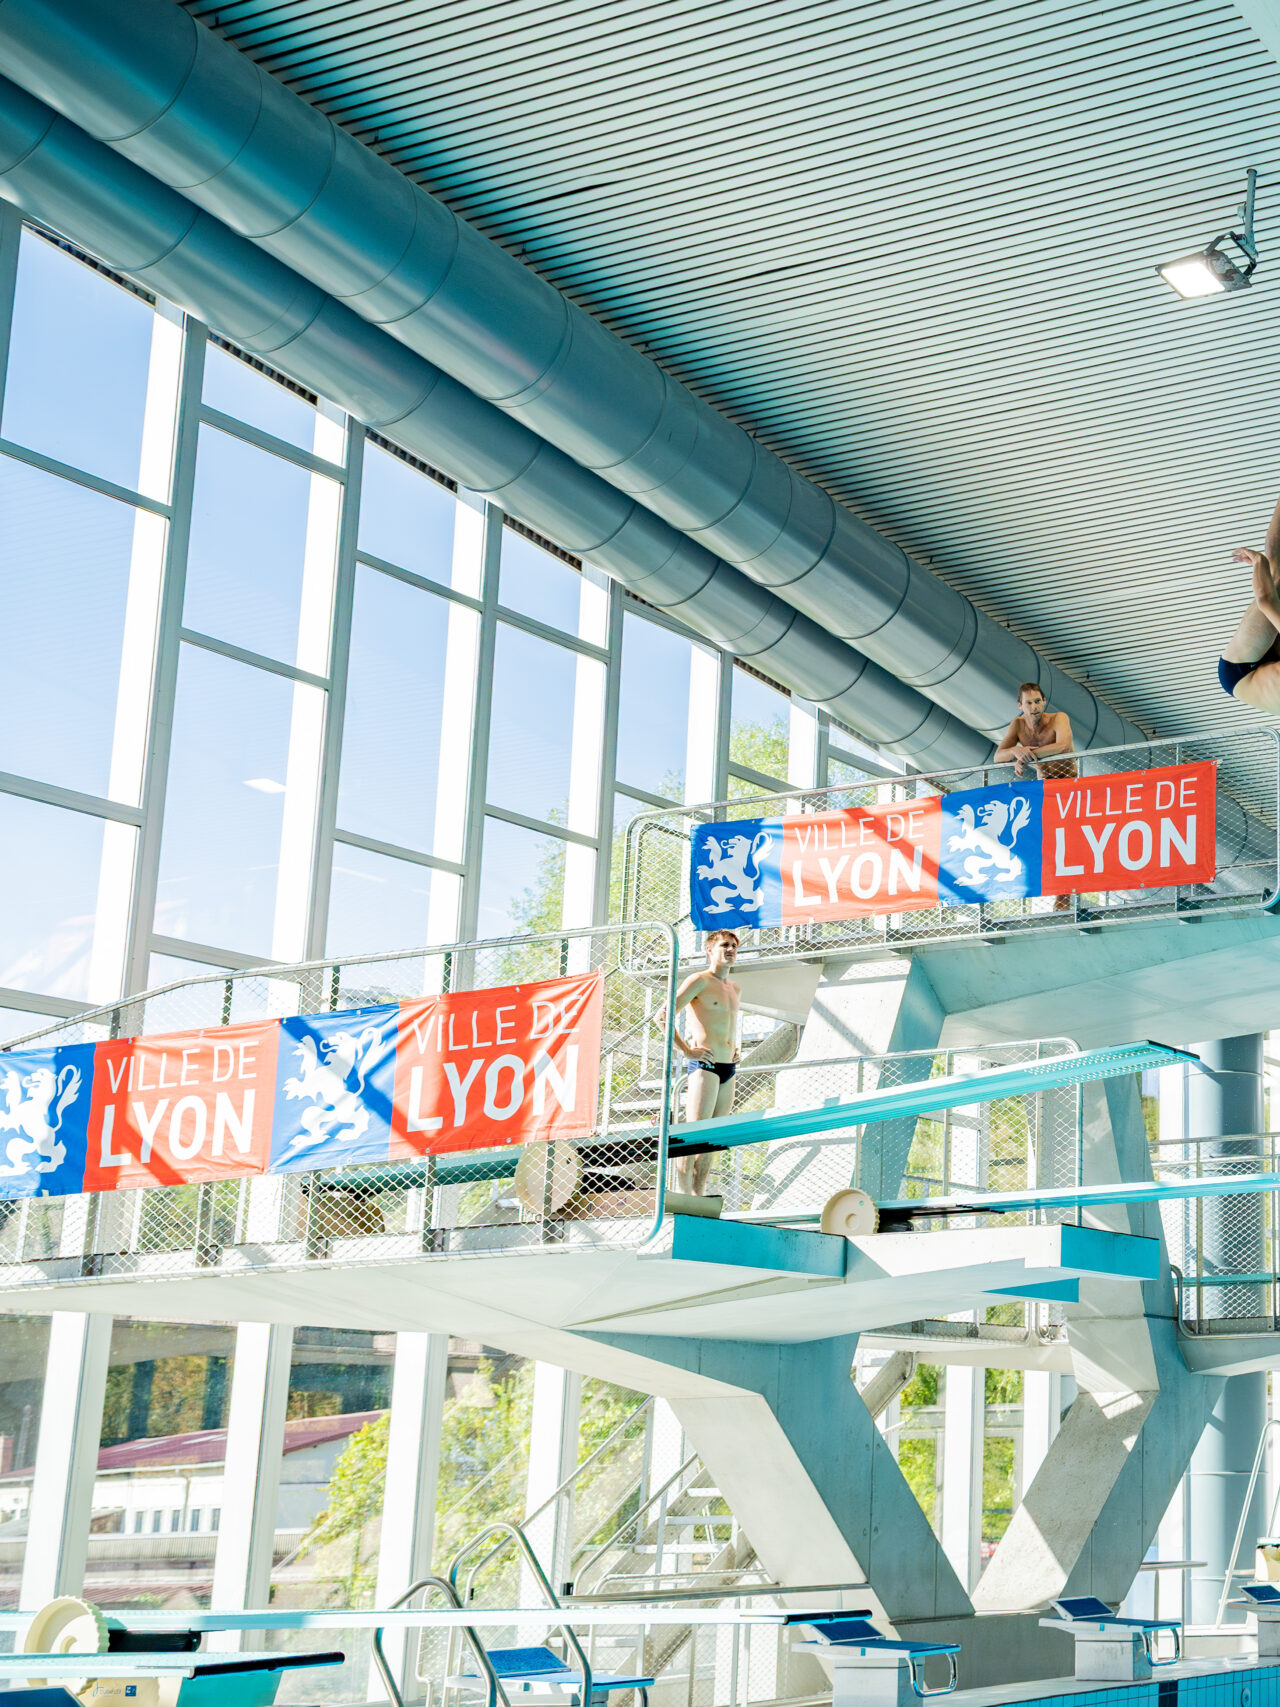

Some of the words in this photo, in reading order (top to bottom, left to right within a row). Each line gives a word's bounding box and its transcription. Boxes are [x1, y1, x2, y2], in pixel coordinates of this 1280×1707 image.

[1056, 783, 1142, 819] VILLE
[1156, 777, 1197, 810] DE
[795, 819, 874, 851] VILLE
[888, 810, 926, 838] DE
[1055, 814, 1197, 877] LYON
[793, 845, 923, 907] LYON
[412, 1005, 516, 1055] VILLE
[531, 996, 583, 1039] DE
[106, 1048, 199, 1095] VILLE
[213, 1041, 260, 1080] DE
[406, 1045, 579, 1133] LYON
[100, 1088, 256, 1168] LYON
